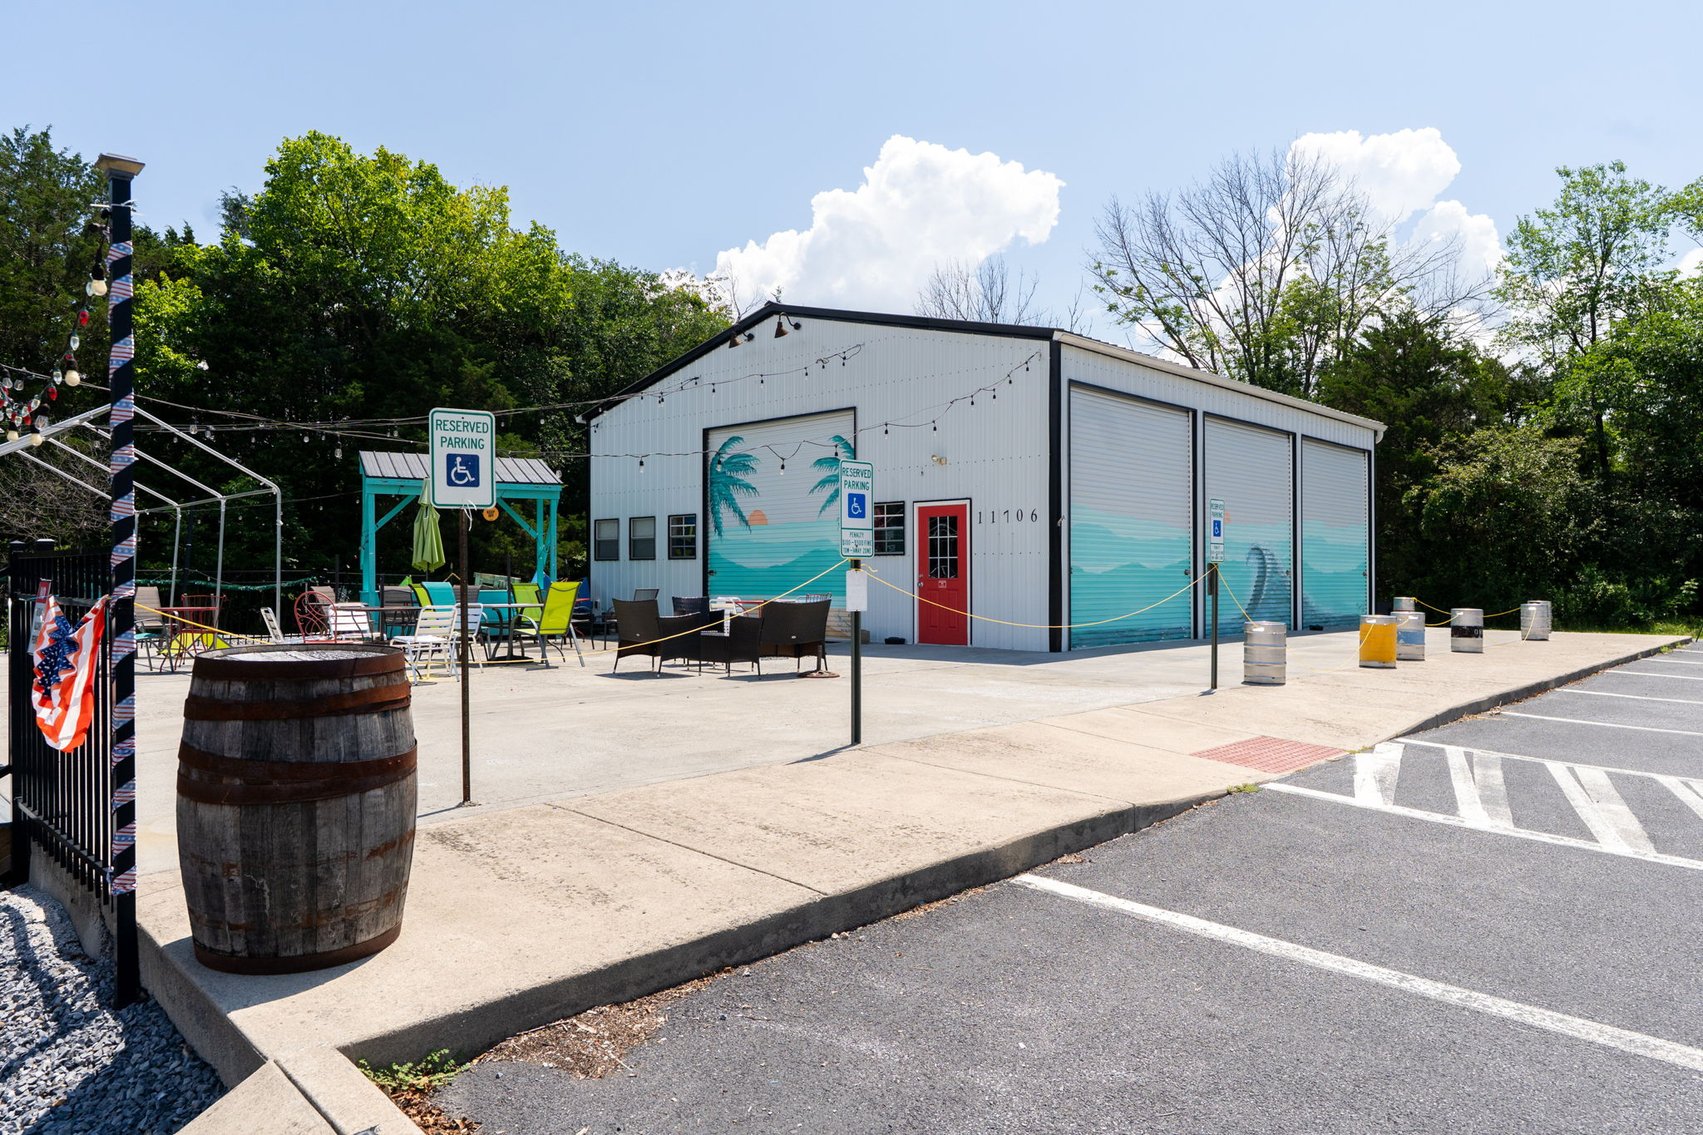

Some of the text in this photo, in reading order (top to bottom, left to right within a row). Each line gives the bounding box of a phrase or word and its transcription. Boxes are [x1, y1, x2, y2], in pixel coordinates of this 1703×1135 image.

[435, 419, 489, 434] RESERVED
[440, 436, 485, 450] PARKING
[842, 467, 871, 479] RESERVED
[844, 479, 870, 491] PARKING
[977, 508, 1038, 524] 11706
